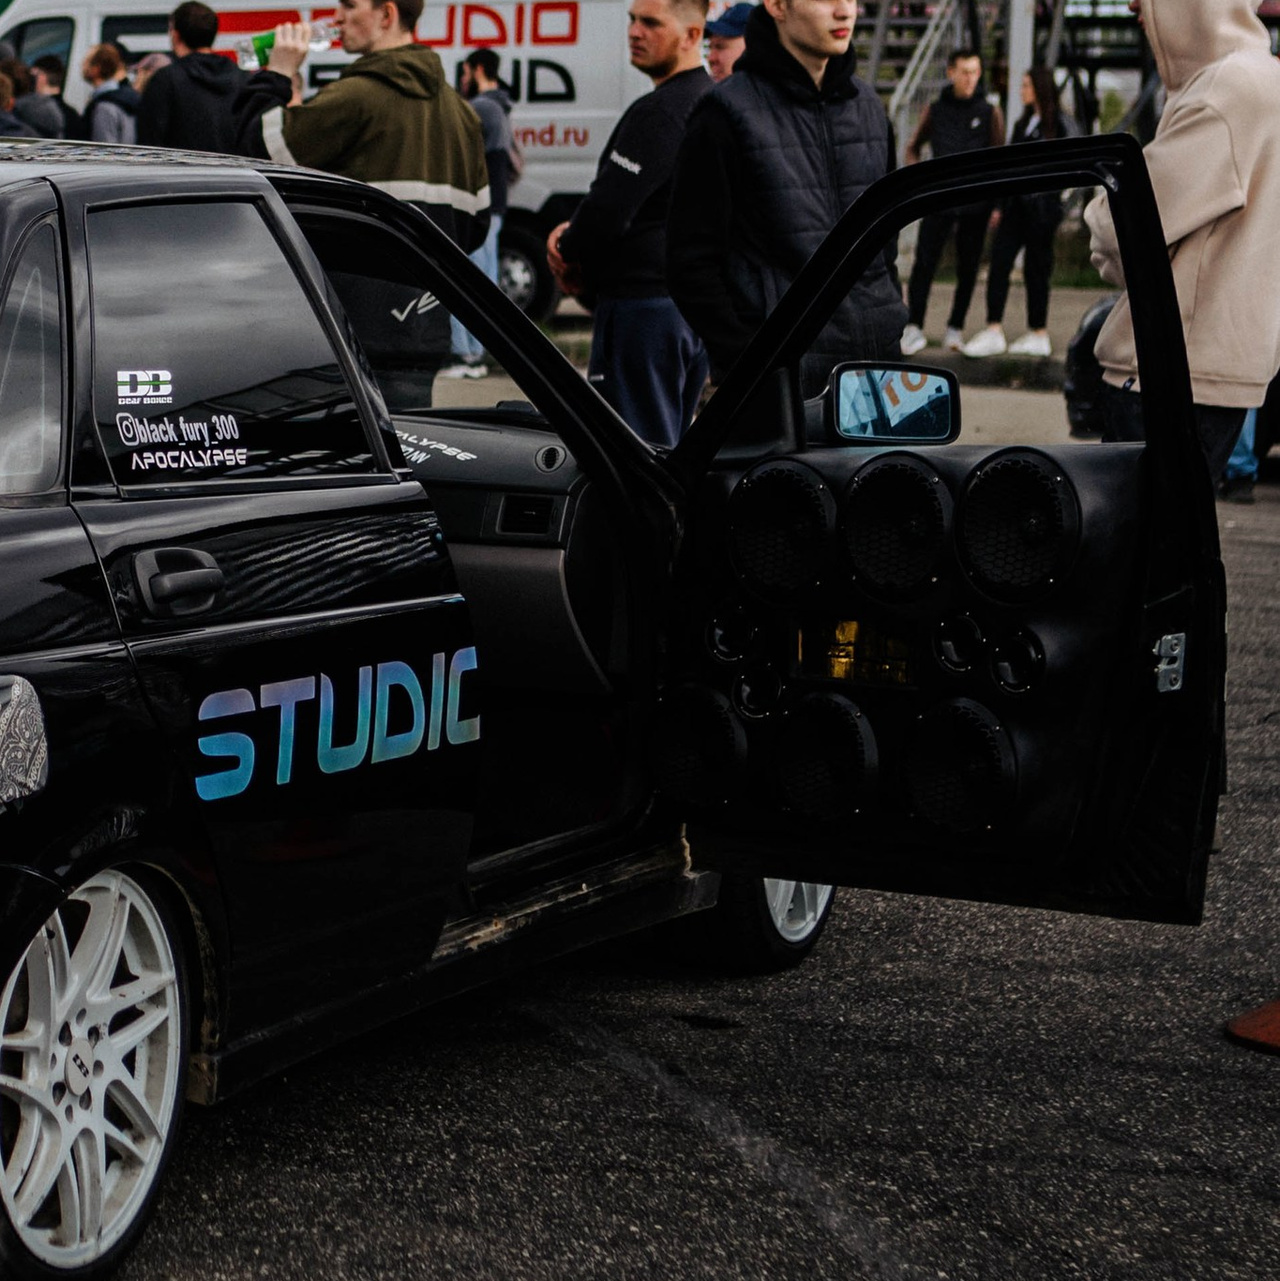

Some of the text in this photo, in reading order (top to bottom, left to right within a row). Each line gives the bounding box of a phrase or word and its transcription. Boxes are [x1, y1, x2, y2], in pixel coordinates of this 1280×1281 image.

[514, 122, 590, 147] nd.ru
[135, 414, 239, 447] black_fury_300
[132, 448, 247, 470] APOCALYPSE
